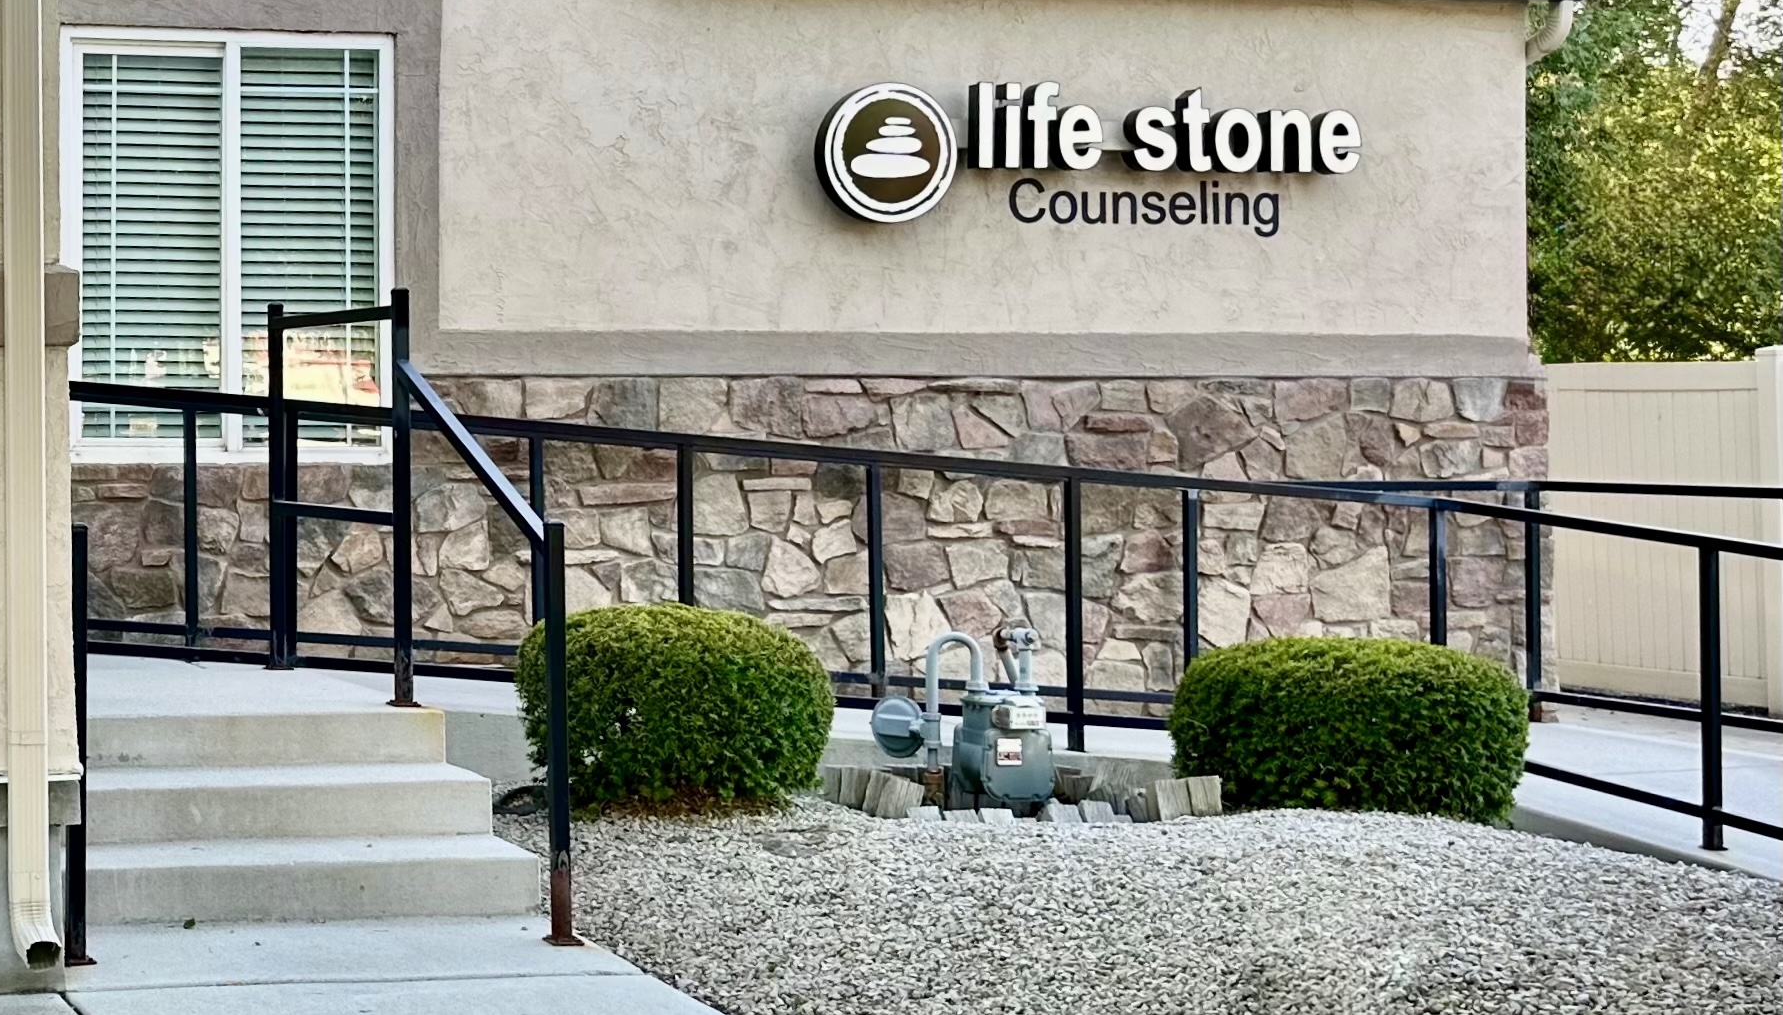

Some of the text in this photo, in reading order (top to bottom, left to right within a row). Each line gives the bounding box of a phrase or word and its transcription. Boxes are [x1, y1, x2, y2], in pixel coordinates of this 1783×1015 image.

[971, 81, 1362, 174] life stone
[1008, 178, 1281, 238] Counseling
